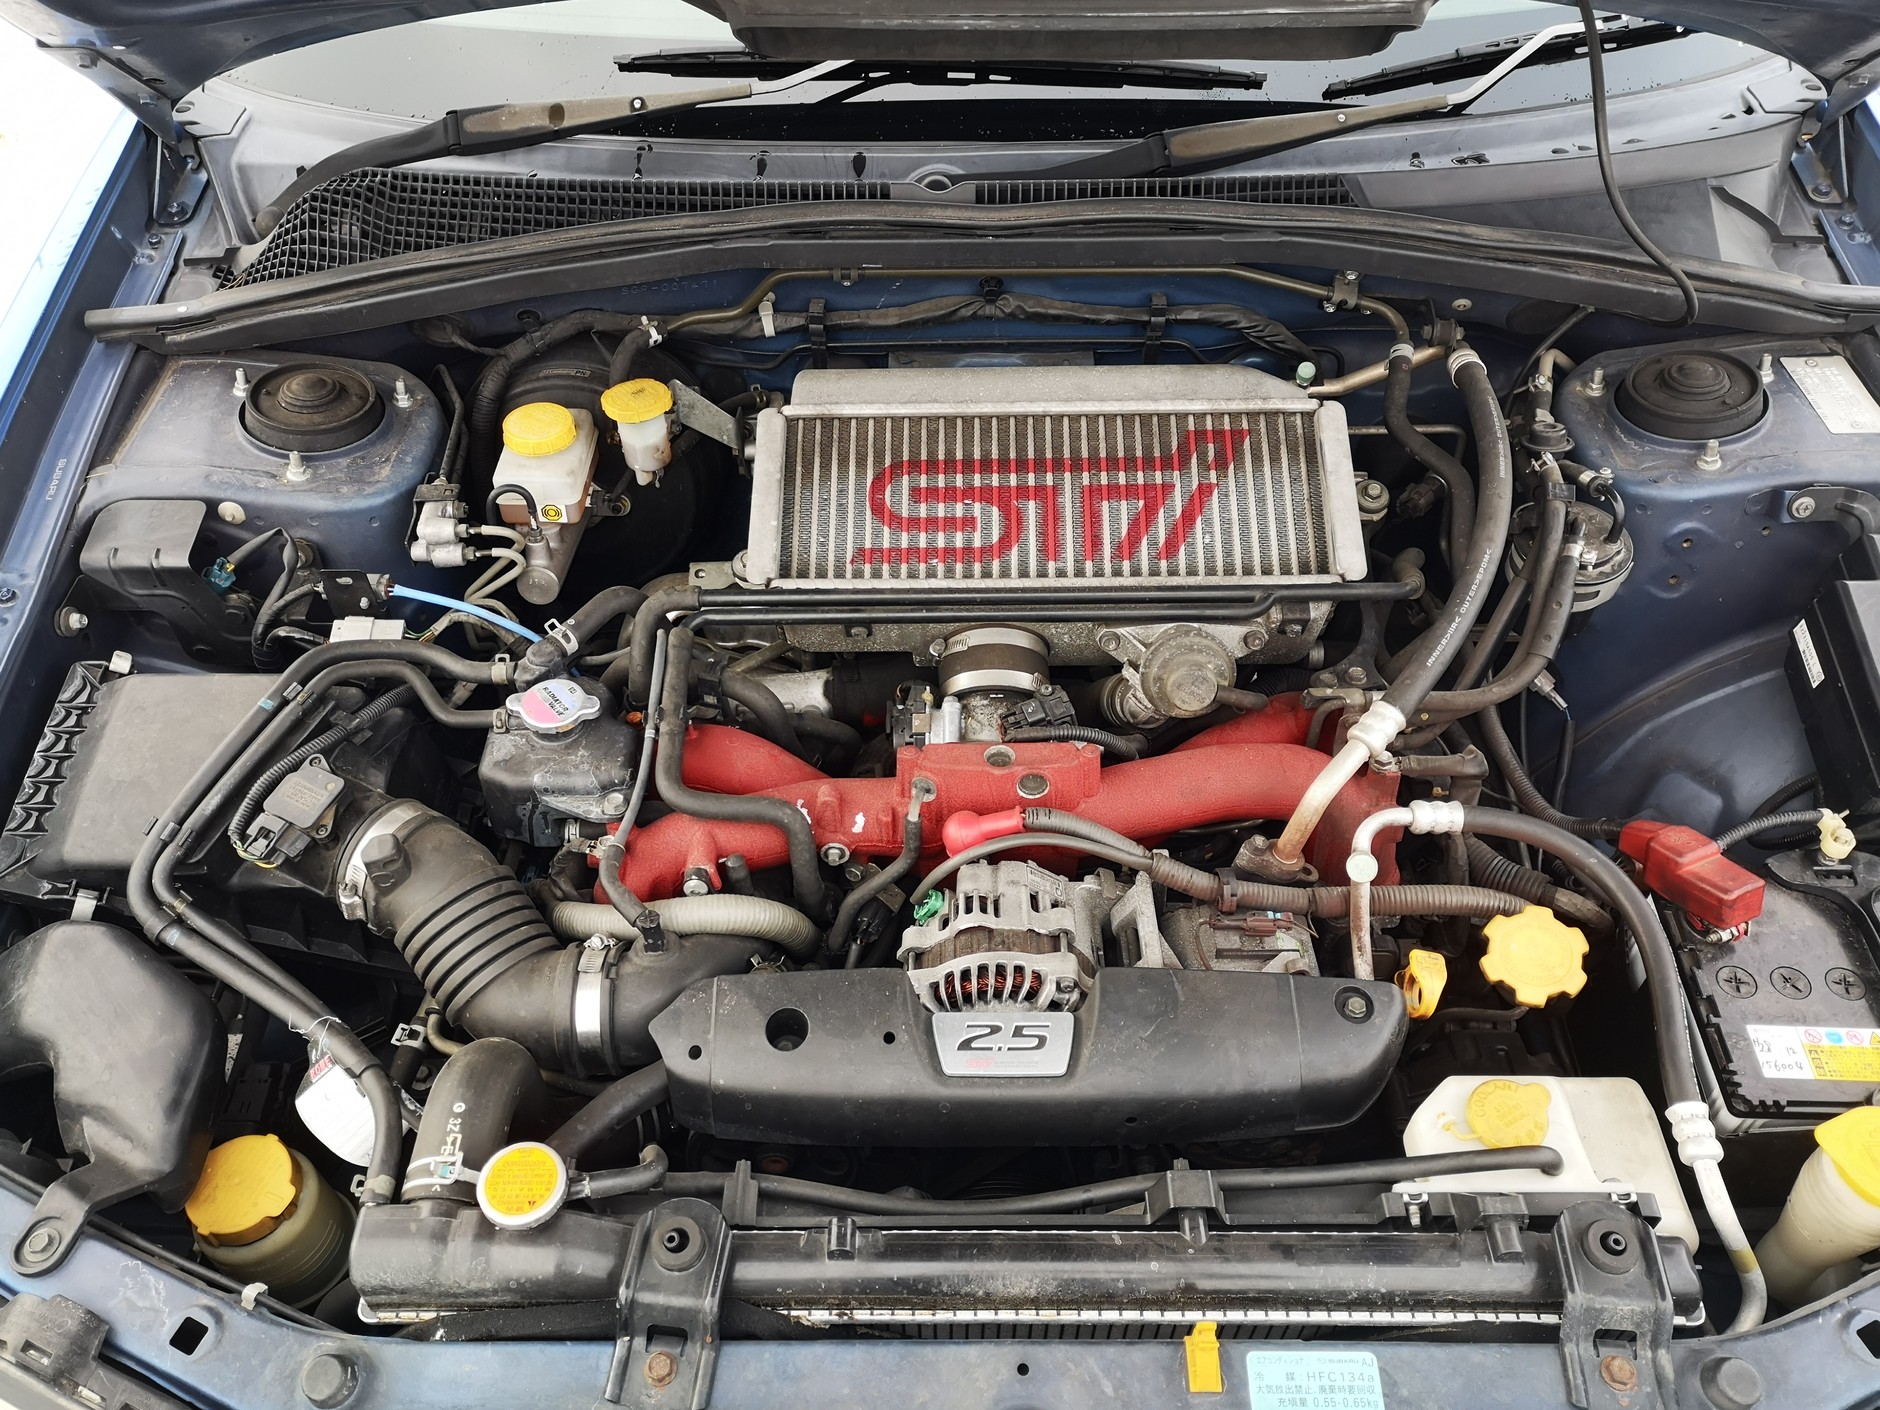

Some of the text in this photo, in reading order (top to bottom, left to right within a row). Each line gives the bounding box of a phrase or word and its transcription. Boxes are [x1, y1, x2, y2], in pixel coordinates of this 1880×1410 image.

[45, 458, 67, 501] SUBARU
[541, 686, 569, 712] RADIATOR
[548, 701, 566, 717] VALVE
[956, 1021, 1052, 1052] 2.5
[1473, 1081, 1520, 1118] COOLANT
[1306, 1371, 1375, 1383] HFC134a
[1313, 1397, 1379, 1410] 0.55-0.65kg
